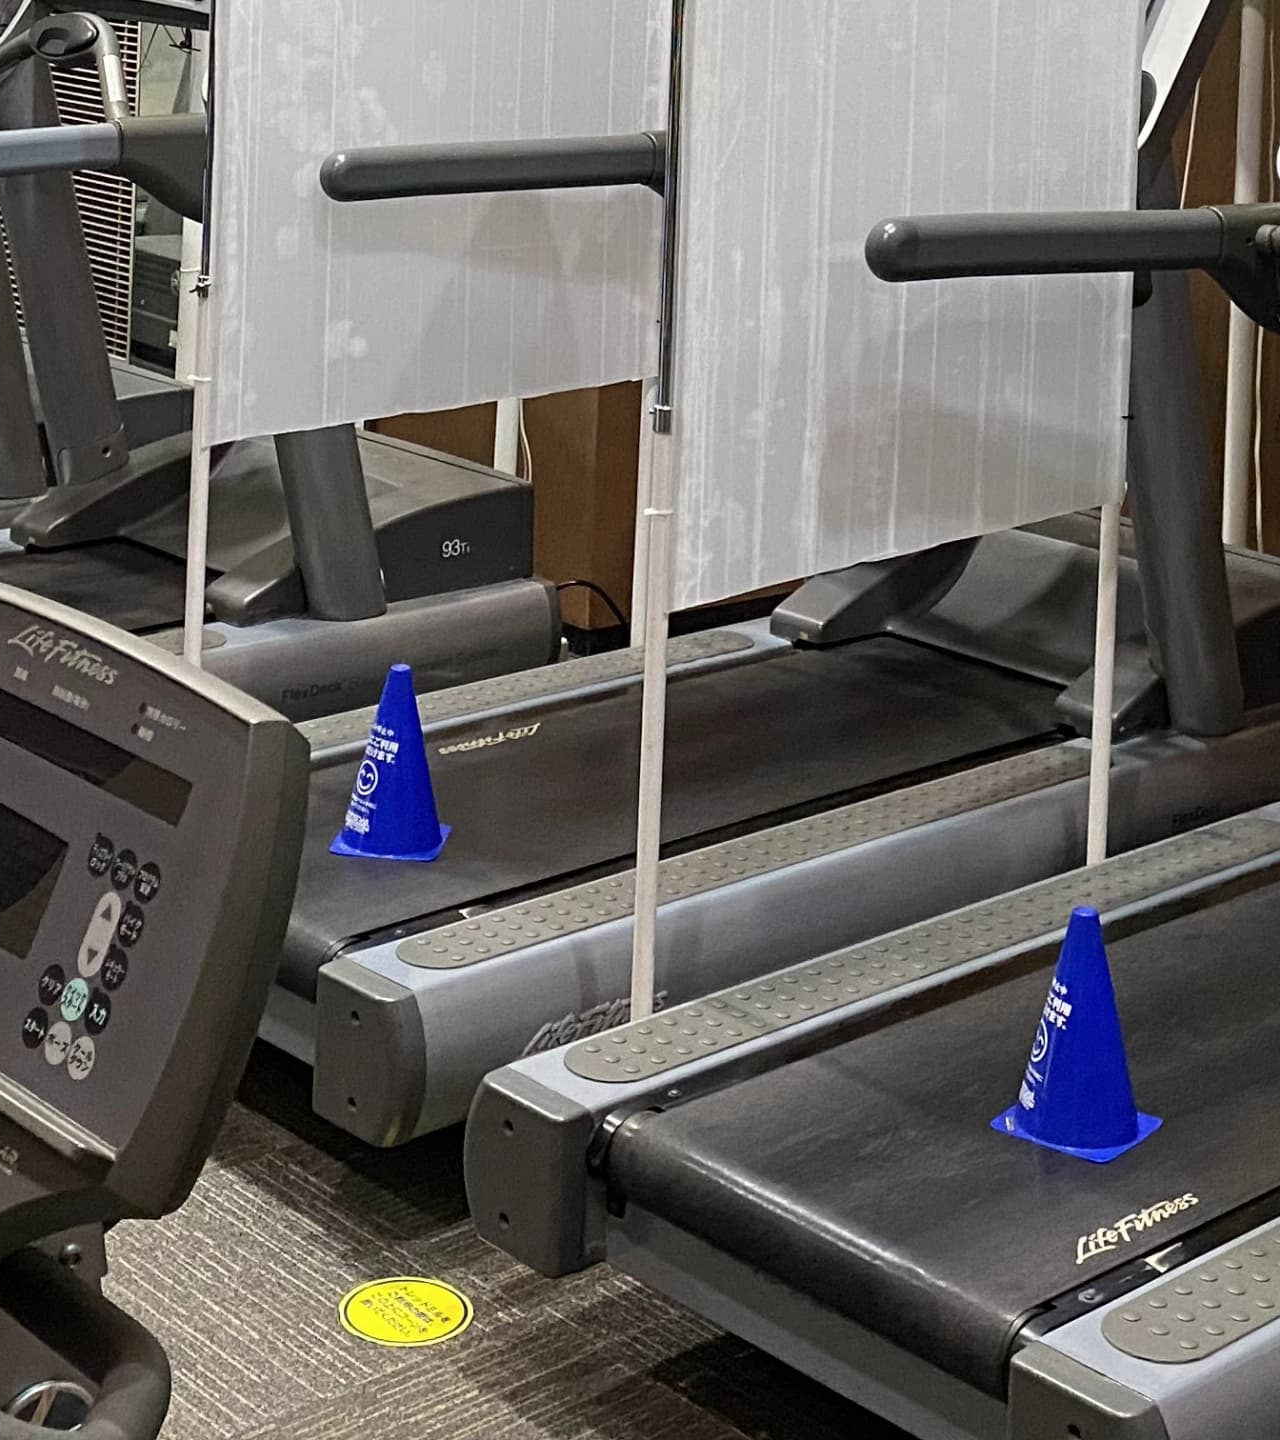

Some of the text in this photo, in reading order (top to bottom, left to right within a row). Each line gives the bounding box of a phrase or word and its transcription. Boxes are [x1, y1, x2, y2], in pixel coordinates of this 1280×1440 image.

[88, 1003, 107, 1026] 入力
[23, 1018, 45, 1040] スタート
